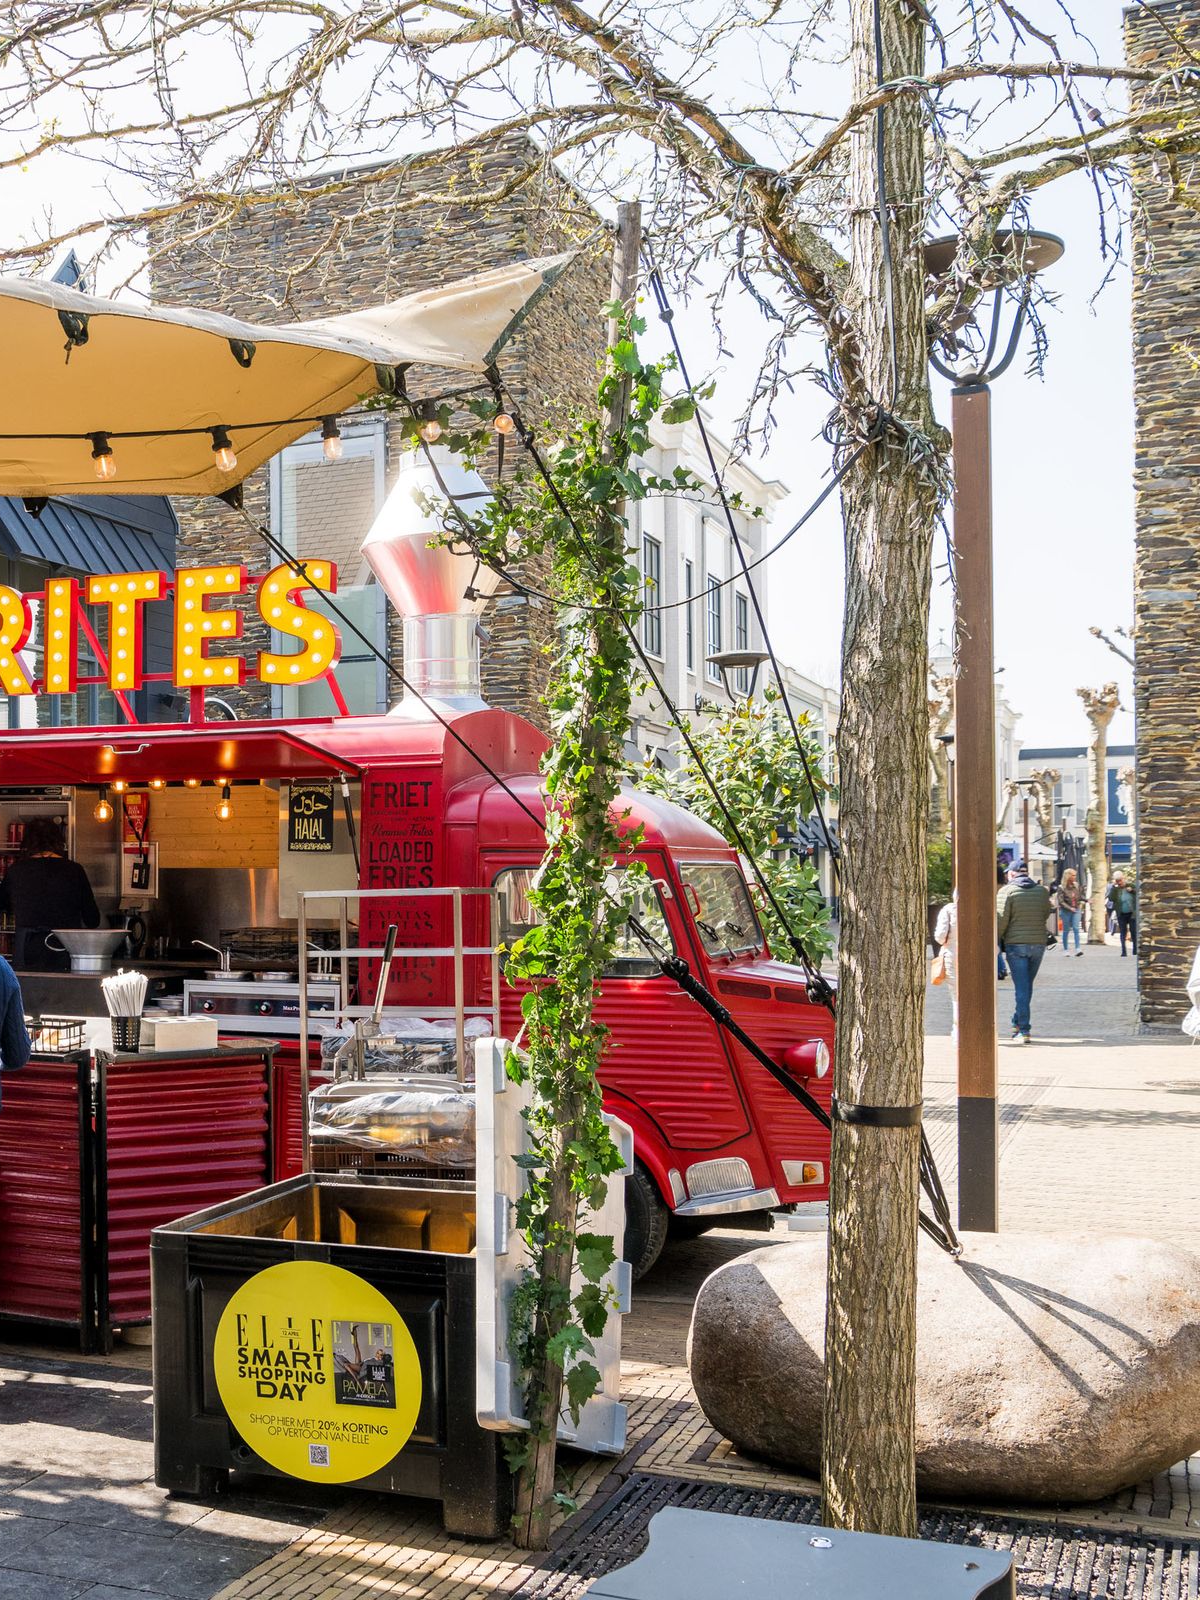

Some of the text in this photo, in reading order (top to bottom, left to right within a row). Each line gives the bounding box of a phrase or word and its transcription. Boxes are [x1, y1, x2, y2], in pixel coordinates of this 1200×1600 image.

[369, 781, 433, 808] FRIET
[295, 817, 326, 840] HALAL
[368, 841, 434, 863] LOADED
[368, 866, 434, 889] FRIES
[235, 1313, 324, 1352] ELLE
[237, 1347, 324, 1371] SMART
[238, 1365, 326, 1385] SHOPPING
[256, 1380, 307, 1402] DAY
[342, 1379, 389, 1397] PAMELA
[249, 1413, 389, 1436] SHOP HIER MET 20% KORTING
[267, 1425, 369, 1445] OP VERTOON VAN ELLE
